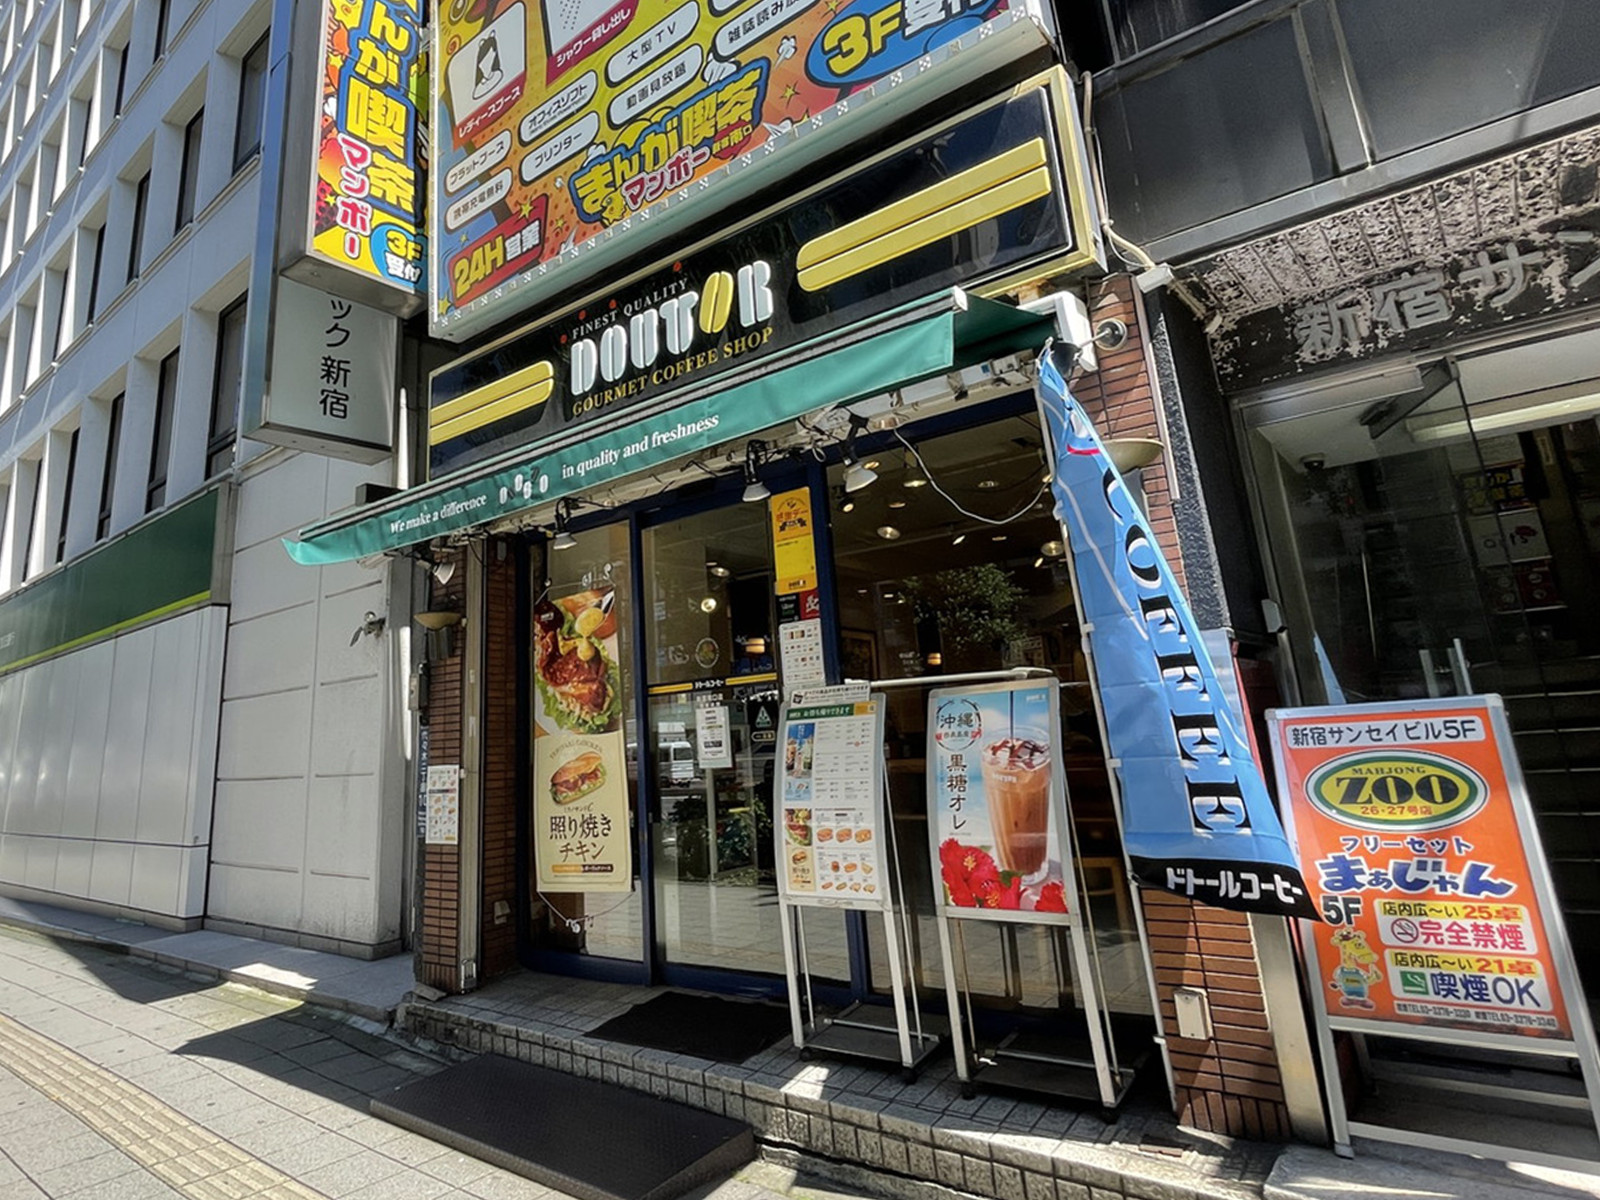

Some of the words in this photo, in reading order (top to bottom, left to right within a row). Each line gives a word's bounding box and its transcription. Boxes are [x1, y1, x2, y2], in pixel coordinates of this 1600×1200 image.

[557, 7, 631, 68] シャワー貸し出し
[626, 60, 687, 110] 動画見放題
[346, 0, 417, 214] んが喫茶
[458, 85, 521, 139] レディースブース
[527, 83, 588, 130] オフィスソフト
[535, 132, 582, 169] プリンター
[574, 68, 762, 215] まんが喫茶
[712, 123, 753, 156] 南口
[450, 139, 505, 187] フラットブース
[622, 147, 711, 211] マンボー
[338, 132, 373, 259] マンボー
[386, 230, 422, 260] 3F
[454, 219, 541, 300] 24H営業
[385, 251, 421, 283] 受付
[572, 309, 618, 340] FINEST
[623, 277, 689, 318] QUALITY
[570, 260, 774, 397] DOUTOR
[572, 374, 649, 416] GOURMET
[651, 348, 719, 386] COFFEE
[722, 326, 774, 359] SHOP
[390, 520, 405, 534] We
[406, 511, 431, 530] make
[432, 510, 439, 522] a
[440, 494, 487, 519] difference
[561, 464, 574, 480] in
[576, 447, 621, 477] quality
[622, 436, 649, 459] and
[651, 414, 720, 448] freshness
[1101, 465, 1253, 840] COFFEE
[940, 712, 974, 730] 沖縄
[1292, 719, 1477, 747] 新宿サンセイビル5F
[1335, 775, 1459, 805] ZOO
[1351, 765, 1426, 776] MAHJONG
[946, 753, 968, 830] 黒糖オレ
[1360, 805, 1433, 816] 26・27号店
[549, 813, 612, 839] 照り焼き
[1341, 837, 1473, 854] フリーセット
[560, 840, 605, 862] チキン
[1165, 866, 1304, 905] ドトールコーヒー
[1317, 855, 1517, 898] まぁじゃん
[1322, 896, 1361, 925] 5F
[1463, 904, 1522, 921] 25卓
[1419, 919, 1526, 951] 完全禁煙
[1477, 958, 1537, 976] 21卓
[1431, 972, 1541, 1007] 喫煙OK
